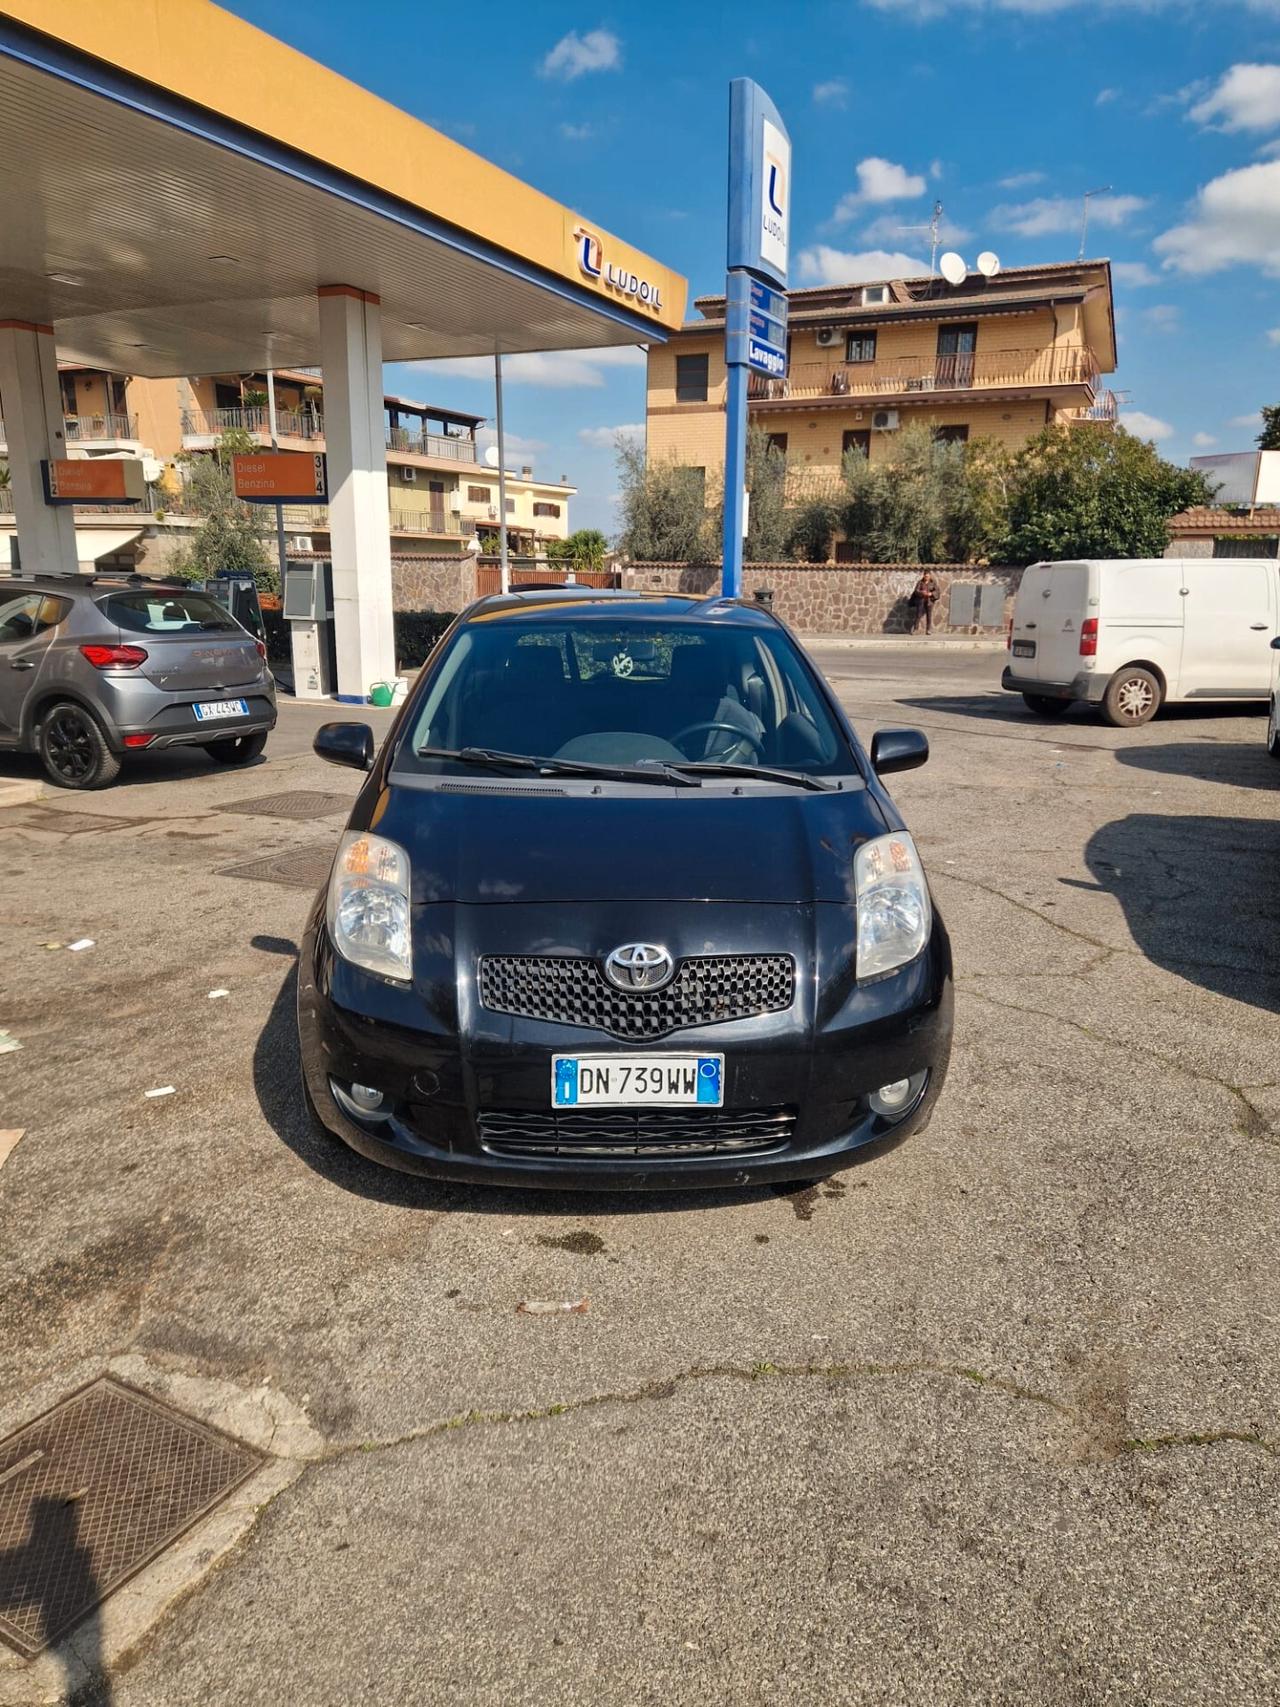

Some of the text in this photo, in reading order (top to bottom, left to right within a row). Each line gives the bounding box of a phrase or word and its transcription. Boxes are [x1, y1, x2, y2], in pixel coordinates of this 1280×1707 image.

[607, 263, 663, 308] LUDOIL
[749, 340, 784, 372] Lavaggio
[49, 462, 55, 474] 1
[236, 462, 266, 473] Diesel
[315, 455, 322, 468] 3
[51, 483, 58, 495] 2
[238, 478, 275, 489] Benzina
[316, 481, 323, 494] 4
[201, 704, 214, 717] GX
[580, 1067, 610, 1094] DN
[618, 1067, 696, 1094] 739WW
